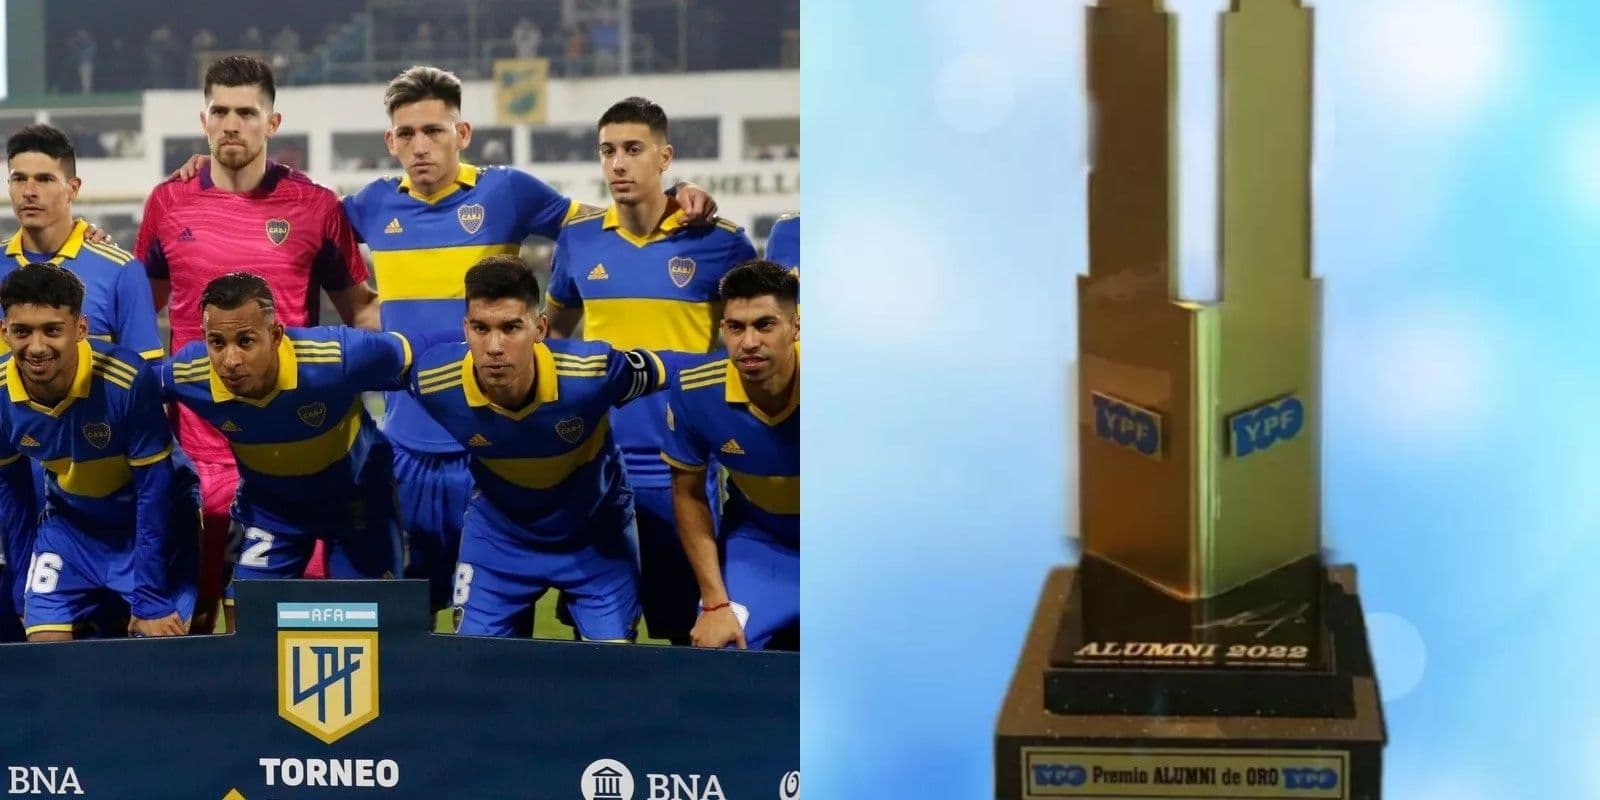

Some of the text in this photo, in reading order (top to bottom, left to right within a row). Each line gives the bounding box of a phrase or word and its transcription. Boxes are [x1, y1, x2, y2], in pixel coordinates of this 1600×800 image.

[1104, 409, 1149, 441] YPF
[1246, 409, 1294, 442] YPF
[311, 608, 344, 622] AFA
[1073, 642, 1309, 659] ALUMNI 2022
[7, 766, 84, 794] BNA
[259, 757, 399, 787] TORNEO
[1093, 766, 1148, 784] Premio
[1153, 767, 1216, 785] ALUMNI
[1222, 768, 1242, 786] de
[1247, 768, 1279, 786] ORO
[646, 773, 727, 800] BNA
